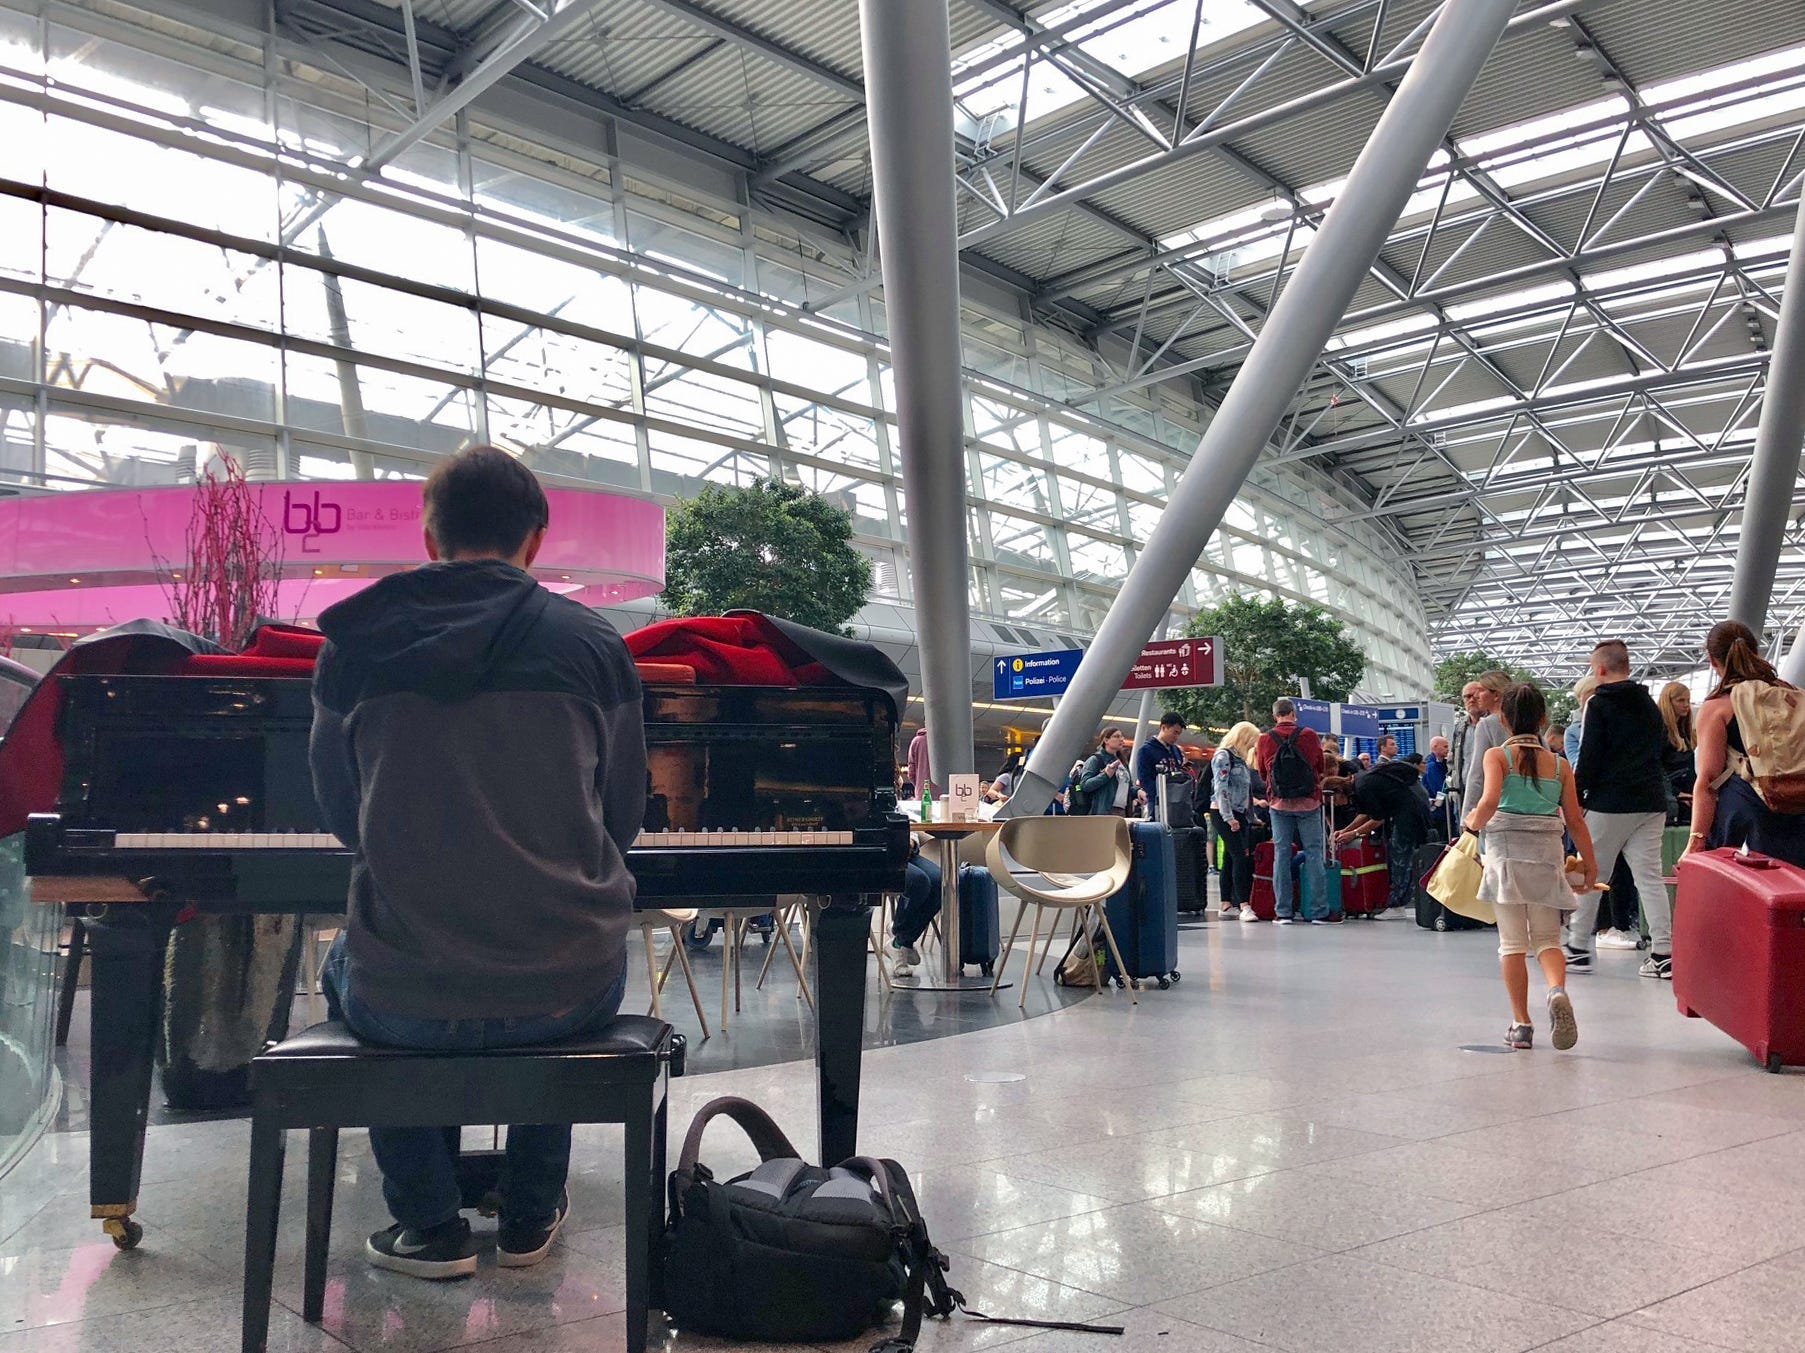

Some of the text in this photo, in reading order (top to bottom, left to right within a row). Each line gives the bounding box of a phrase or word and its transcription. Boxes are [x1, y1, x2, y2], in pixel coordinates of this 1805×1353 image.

[347, 508, 421, 521] Bar & Bistr
[1141, 648, 1176, 657] Restaurants
[1024, 658, 1060, 668] Information
[1025, 676, 1045, 685] Polizei
[1048, 675, 1067, 684] Police
